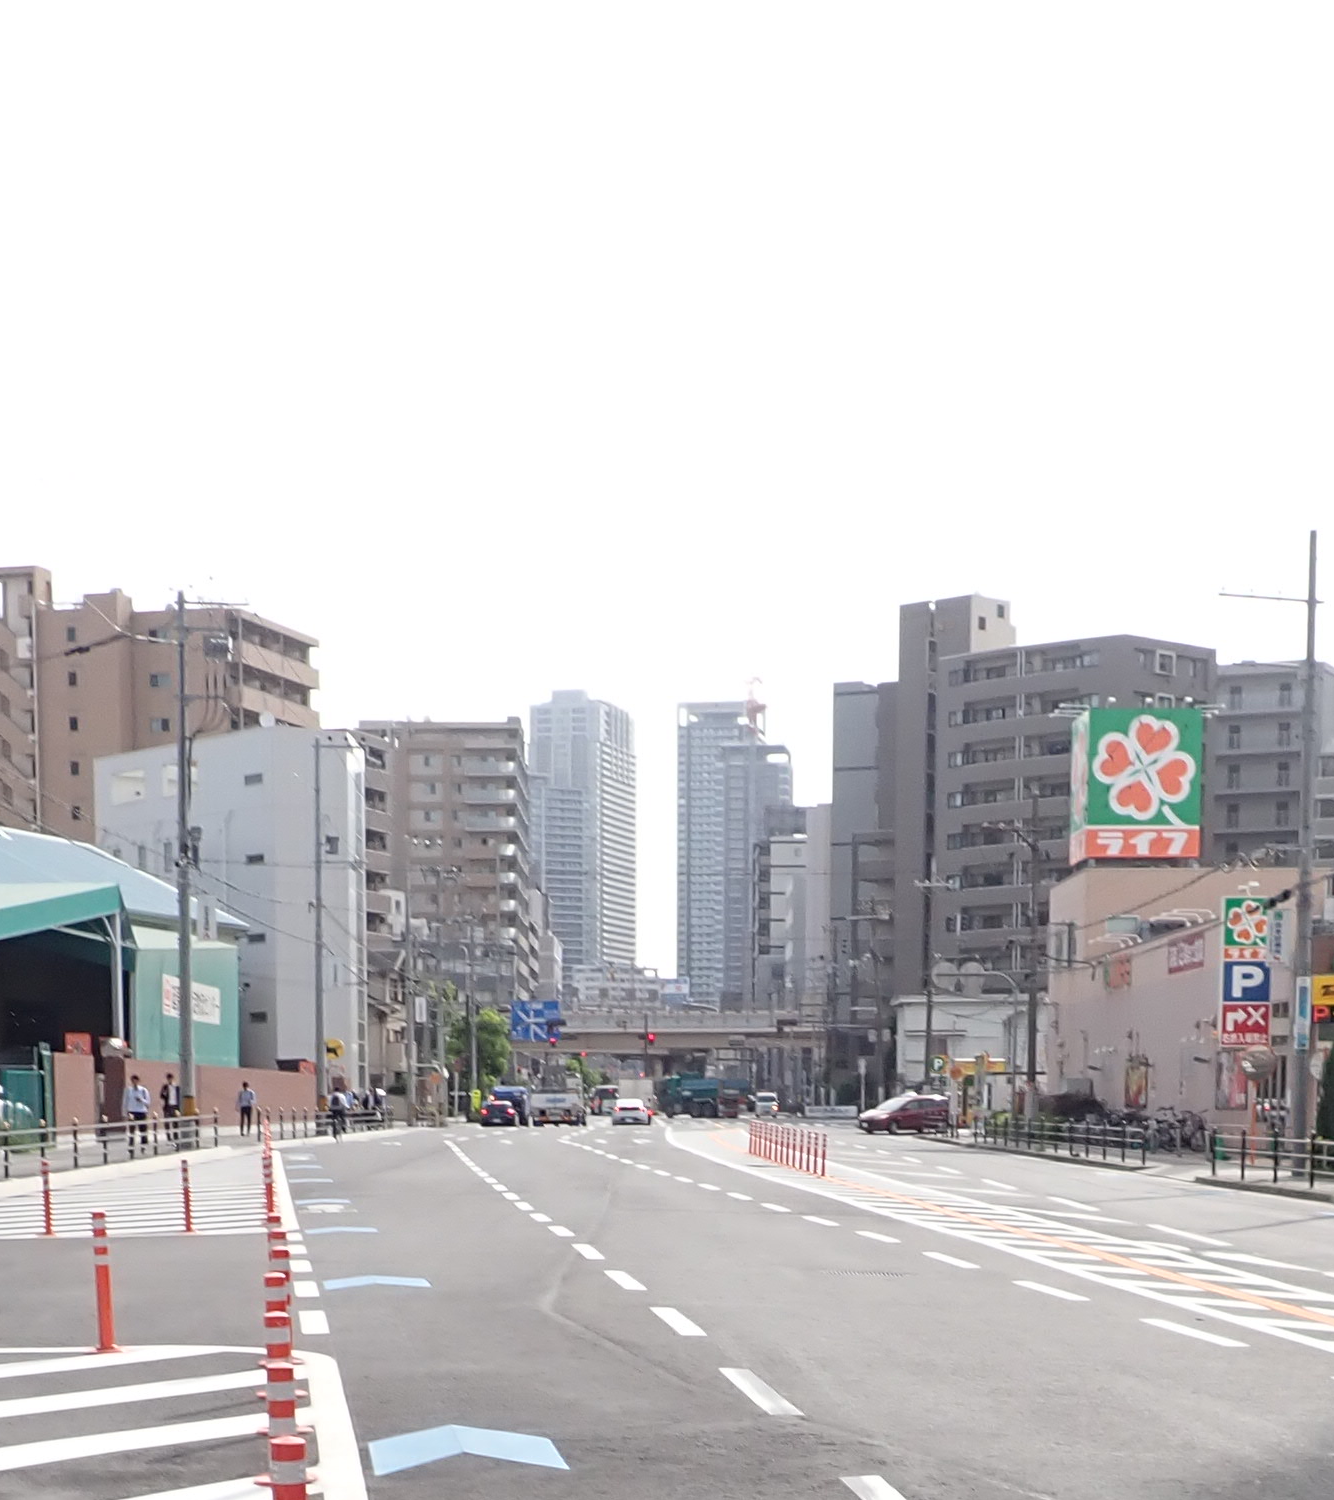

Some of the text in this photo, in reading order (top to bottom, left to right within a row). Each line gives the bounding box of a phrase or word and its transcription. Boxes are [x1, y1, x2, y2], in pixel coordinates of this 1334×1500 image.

[1096, 831, 1189, 855] ライフ
[1231, 965, 1265, 998] P
[1313, 1005, 1331, 1023] P
